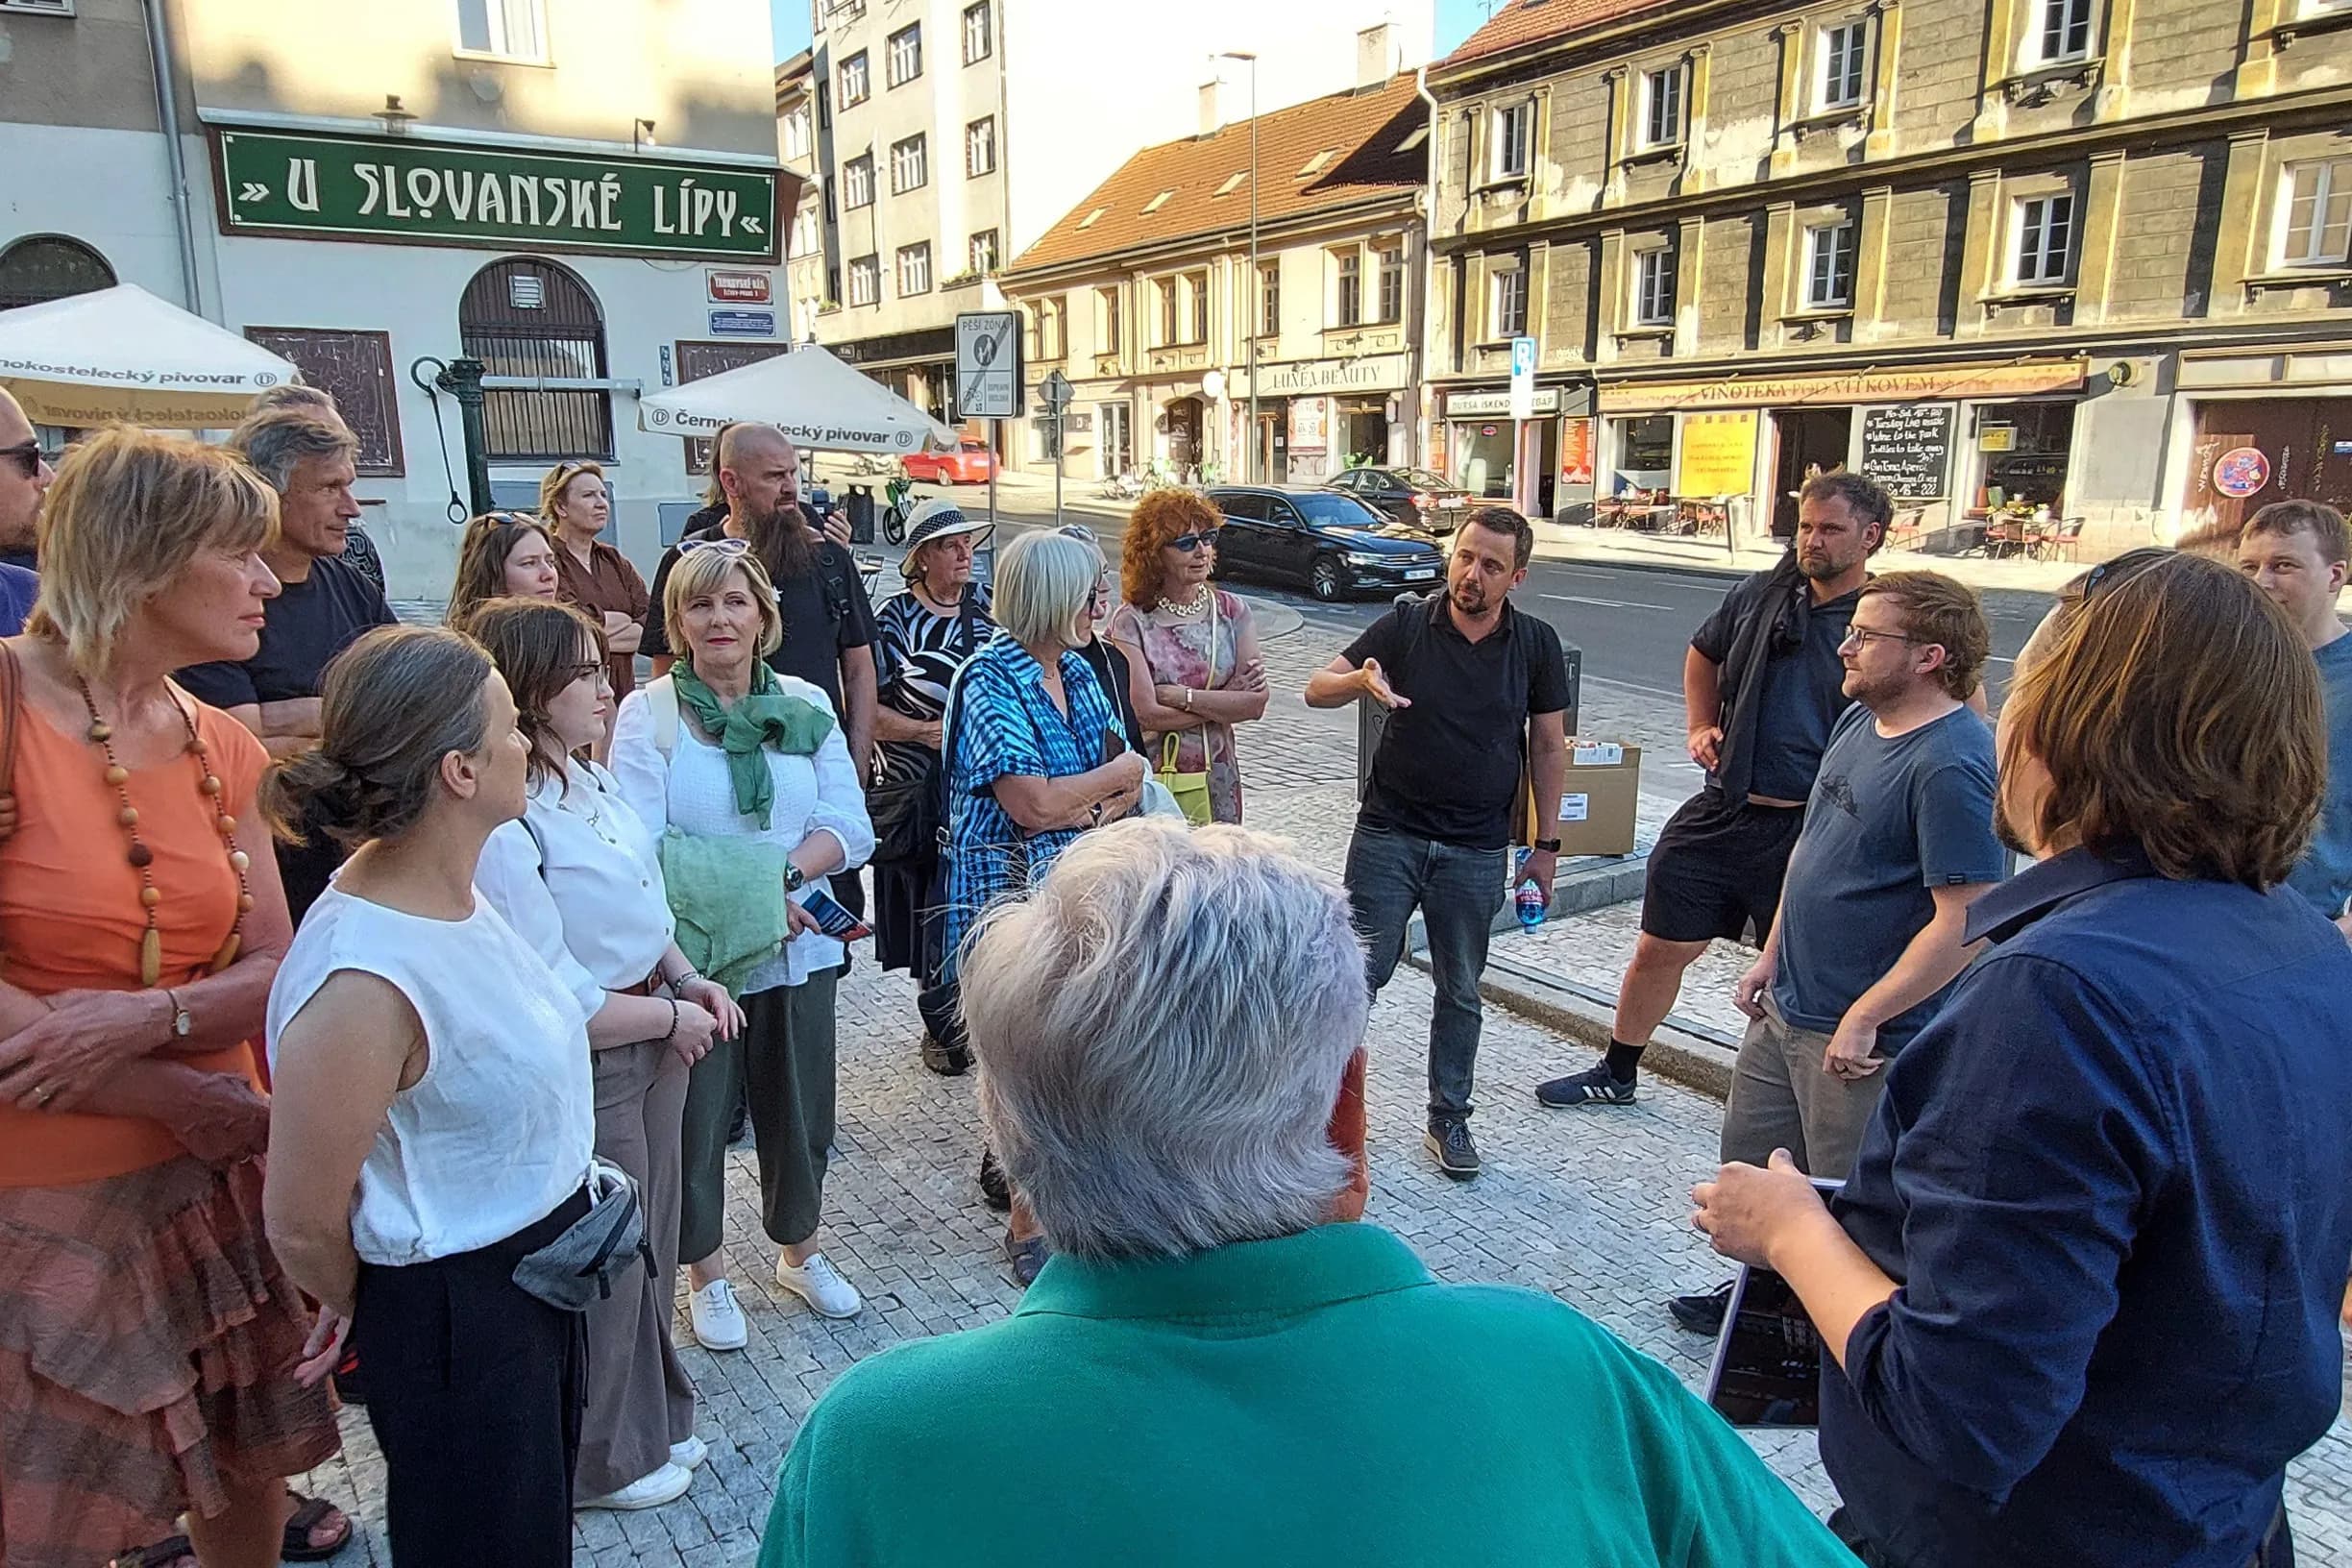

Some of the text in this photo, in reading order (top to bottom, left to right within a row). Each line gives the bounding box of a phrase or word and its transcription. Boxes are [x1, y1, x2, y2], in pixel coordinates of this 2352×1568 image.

[288, 158, 738, 237] U SLOVANSKÉ LÍPY
[159, 372, 246, 384] pivovar
[1320, 364, 1381, 385] BEAUTY
[1700, 383, 1787, 401] VINOTEKA
[825, 427, 891, 445] pivovar
